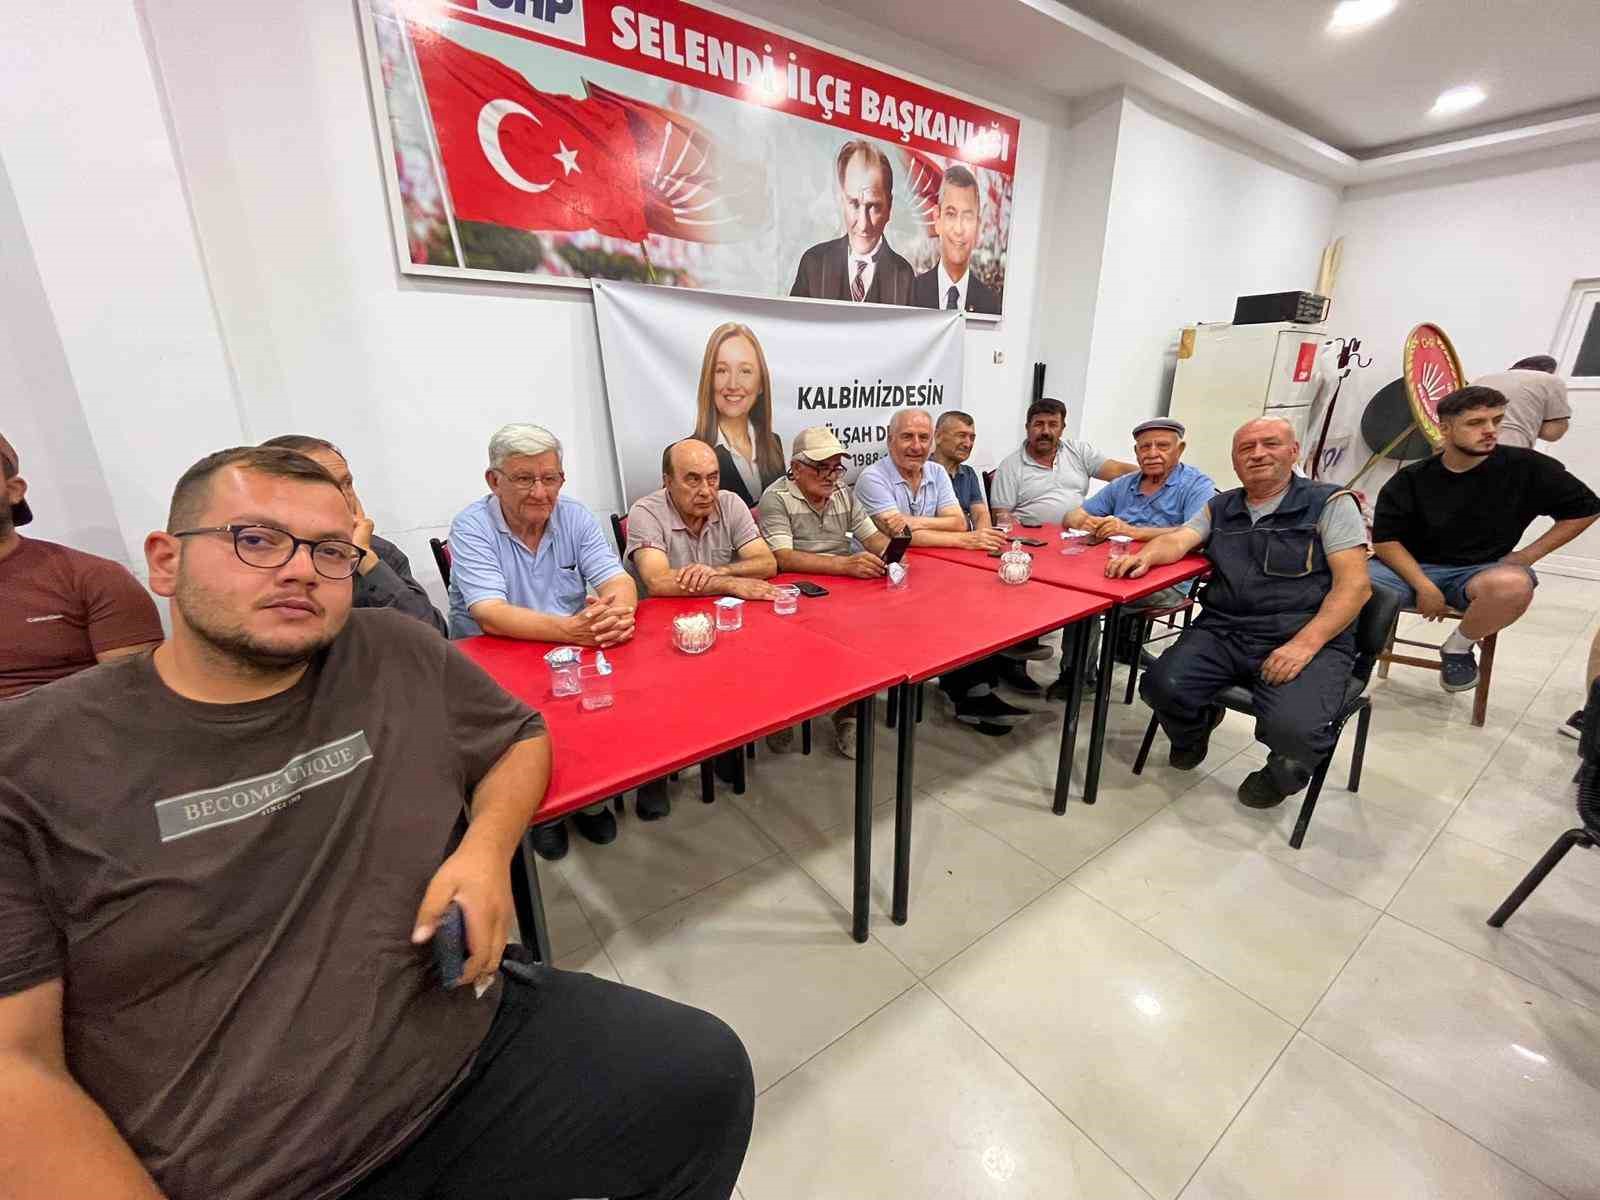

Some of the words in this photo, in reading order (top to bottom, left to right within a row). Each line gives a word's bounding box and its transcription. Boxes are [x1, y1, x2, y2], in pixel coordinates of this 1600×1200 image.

[610, 5, 776, 93] SELENDİ
[787, 52, 851, 120] İLÇE
[797, 379, 944, 410] KALBİMİZDESİN
[184, 779, 282, 821] BECOME
